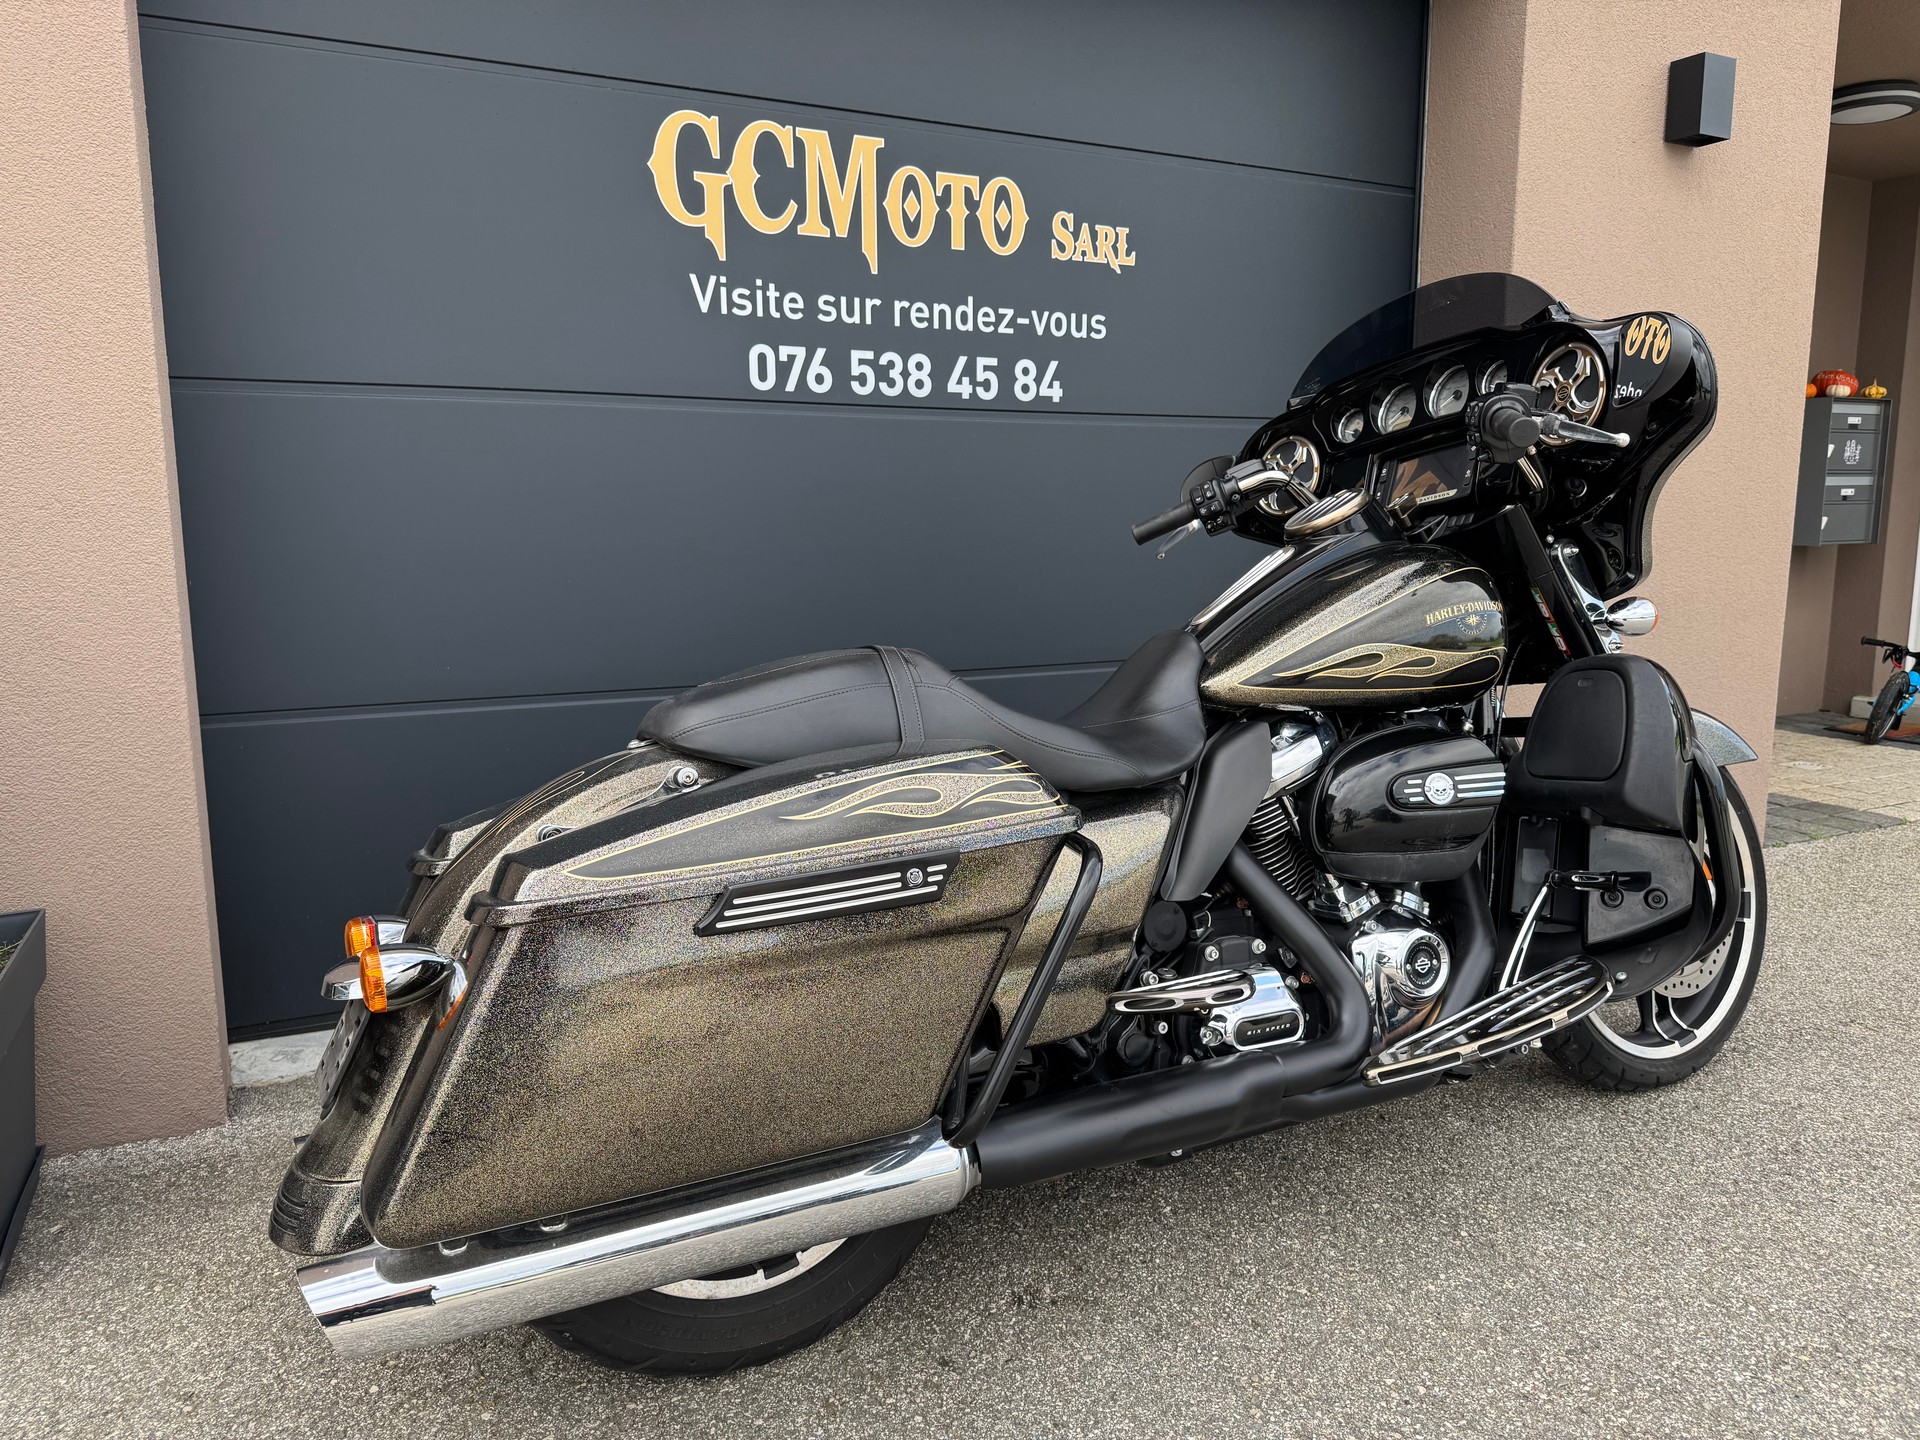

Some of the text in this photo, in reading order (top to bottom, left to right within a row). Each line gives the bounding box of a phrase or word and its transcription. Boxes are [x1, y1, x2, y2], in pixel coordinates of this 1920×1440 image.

[647, 109, 1136, 274] GCMOTO SARL
[689, 273, 1107, 340] Visite sur rendez-vous
[748, 343, 1063, 403] 076 538 45 84
[1265, 1023, 1291, 1033] SPEED
